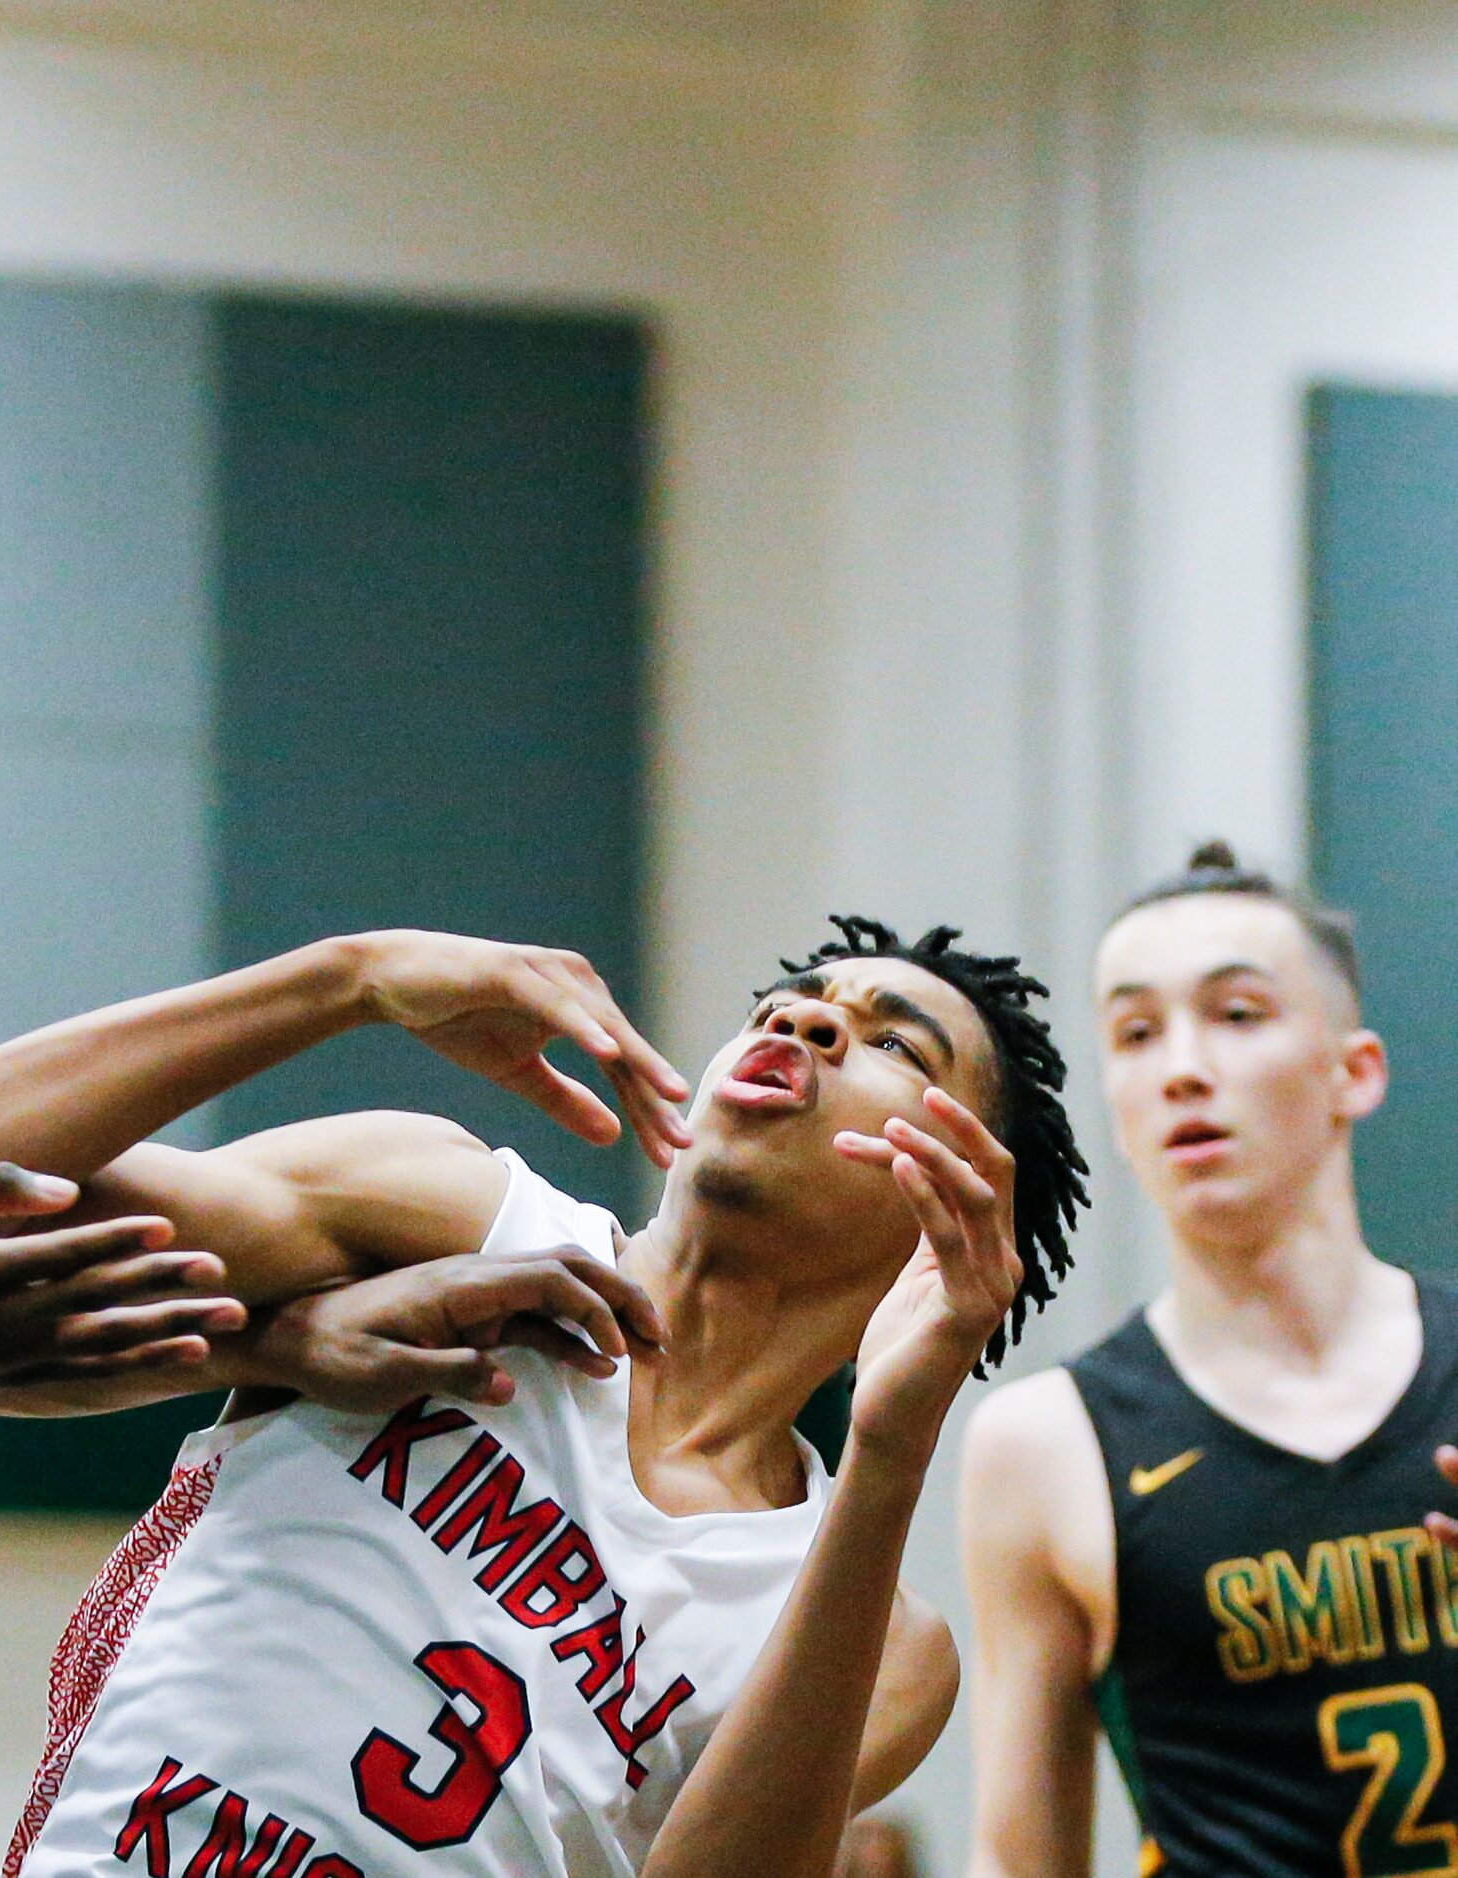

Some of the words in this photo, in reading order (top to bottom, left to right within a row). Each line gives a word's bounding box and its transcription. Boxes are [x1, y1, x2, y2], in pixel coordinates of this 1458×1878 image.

[347, 1394, 697, 1792] KIMBALL
[350, 1640, 533, 1853] 3
[1316, 1682, 1458, 1878] 2
